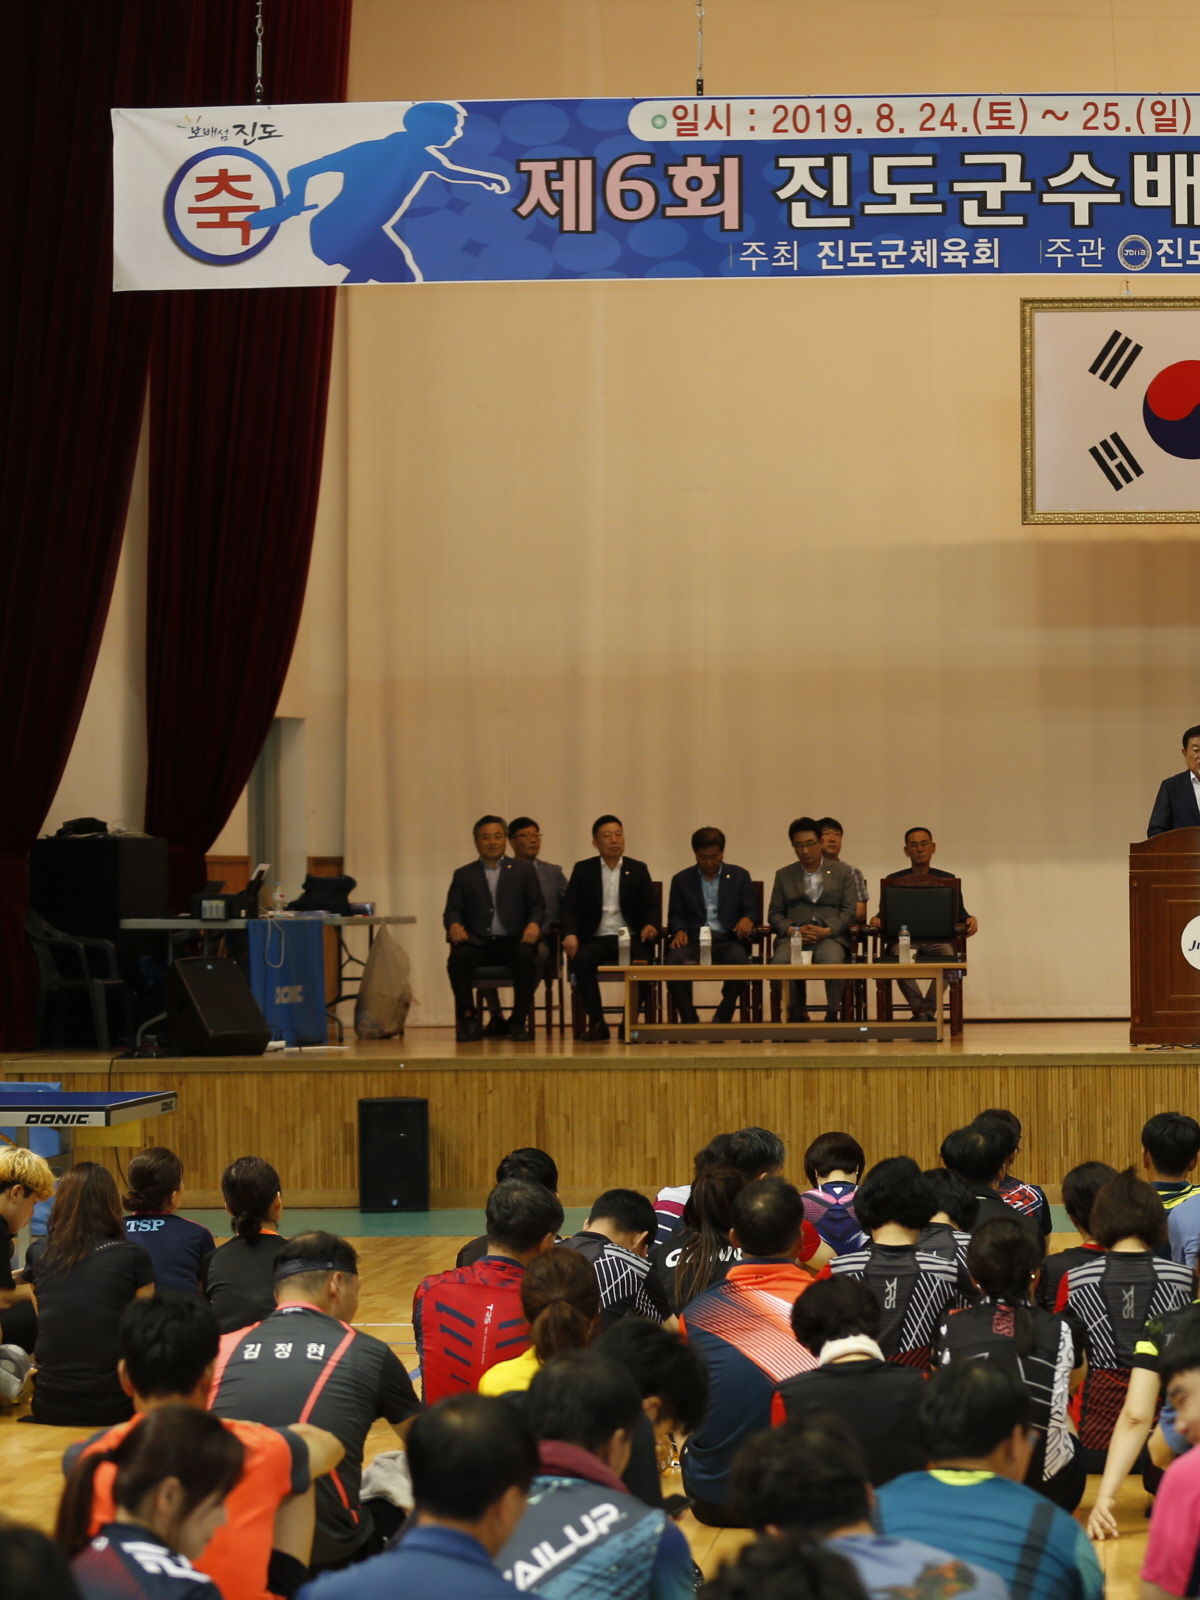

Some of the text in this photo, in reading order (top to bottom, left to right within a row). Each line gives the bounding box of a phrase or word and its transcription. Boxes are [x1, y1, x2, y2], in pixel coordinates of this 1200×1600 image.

[232, 122, 284, 146] 진도
[672, 103, 732, 137] 일시
[187, 168, 260, 246] 축
[512, 151, 744, 234] 제6회
[738, 237, 1000, 271] 주최 진도군체육회
[1044, 237, 1106, 268] 주관
[25, 1114, 89, 1125] DONIC
[126, 1219, 165, 1233] TSP
[502, 1502, 620, 1591] AILUP
